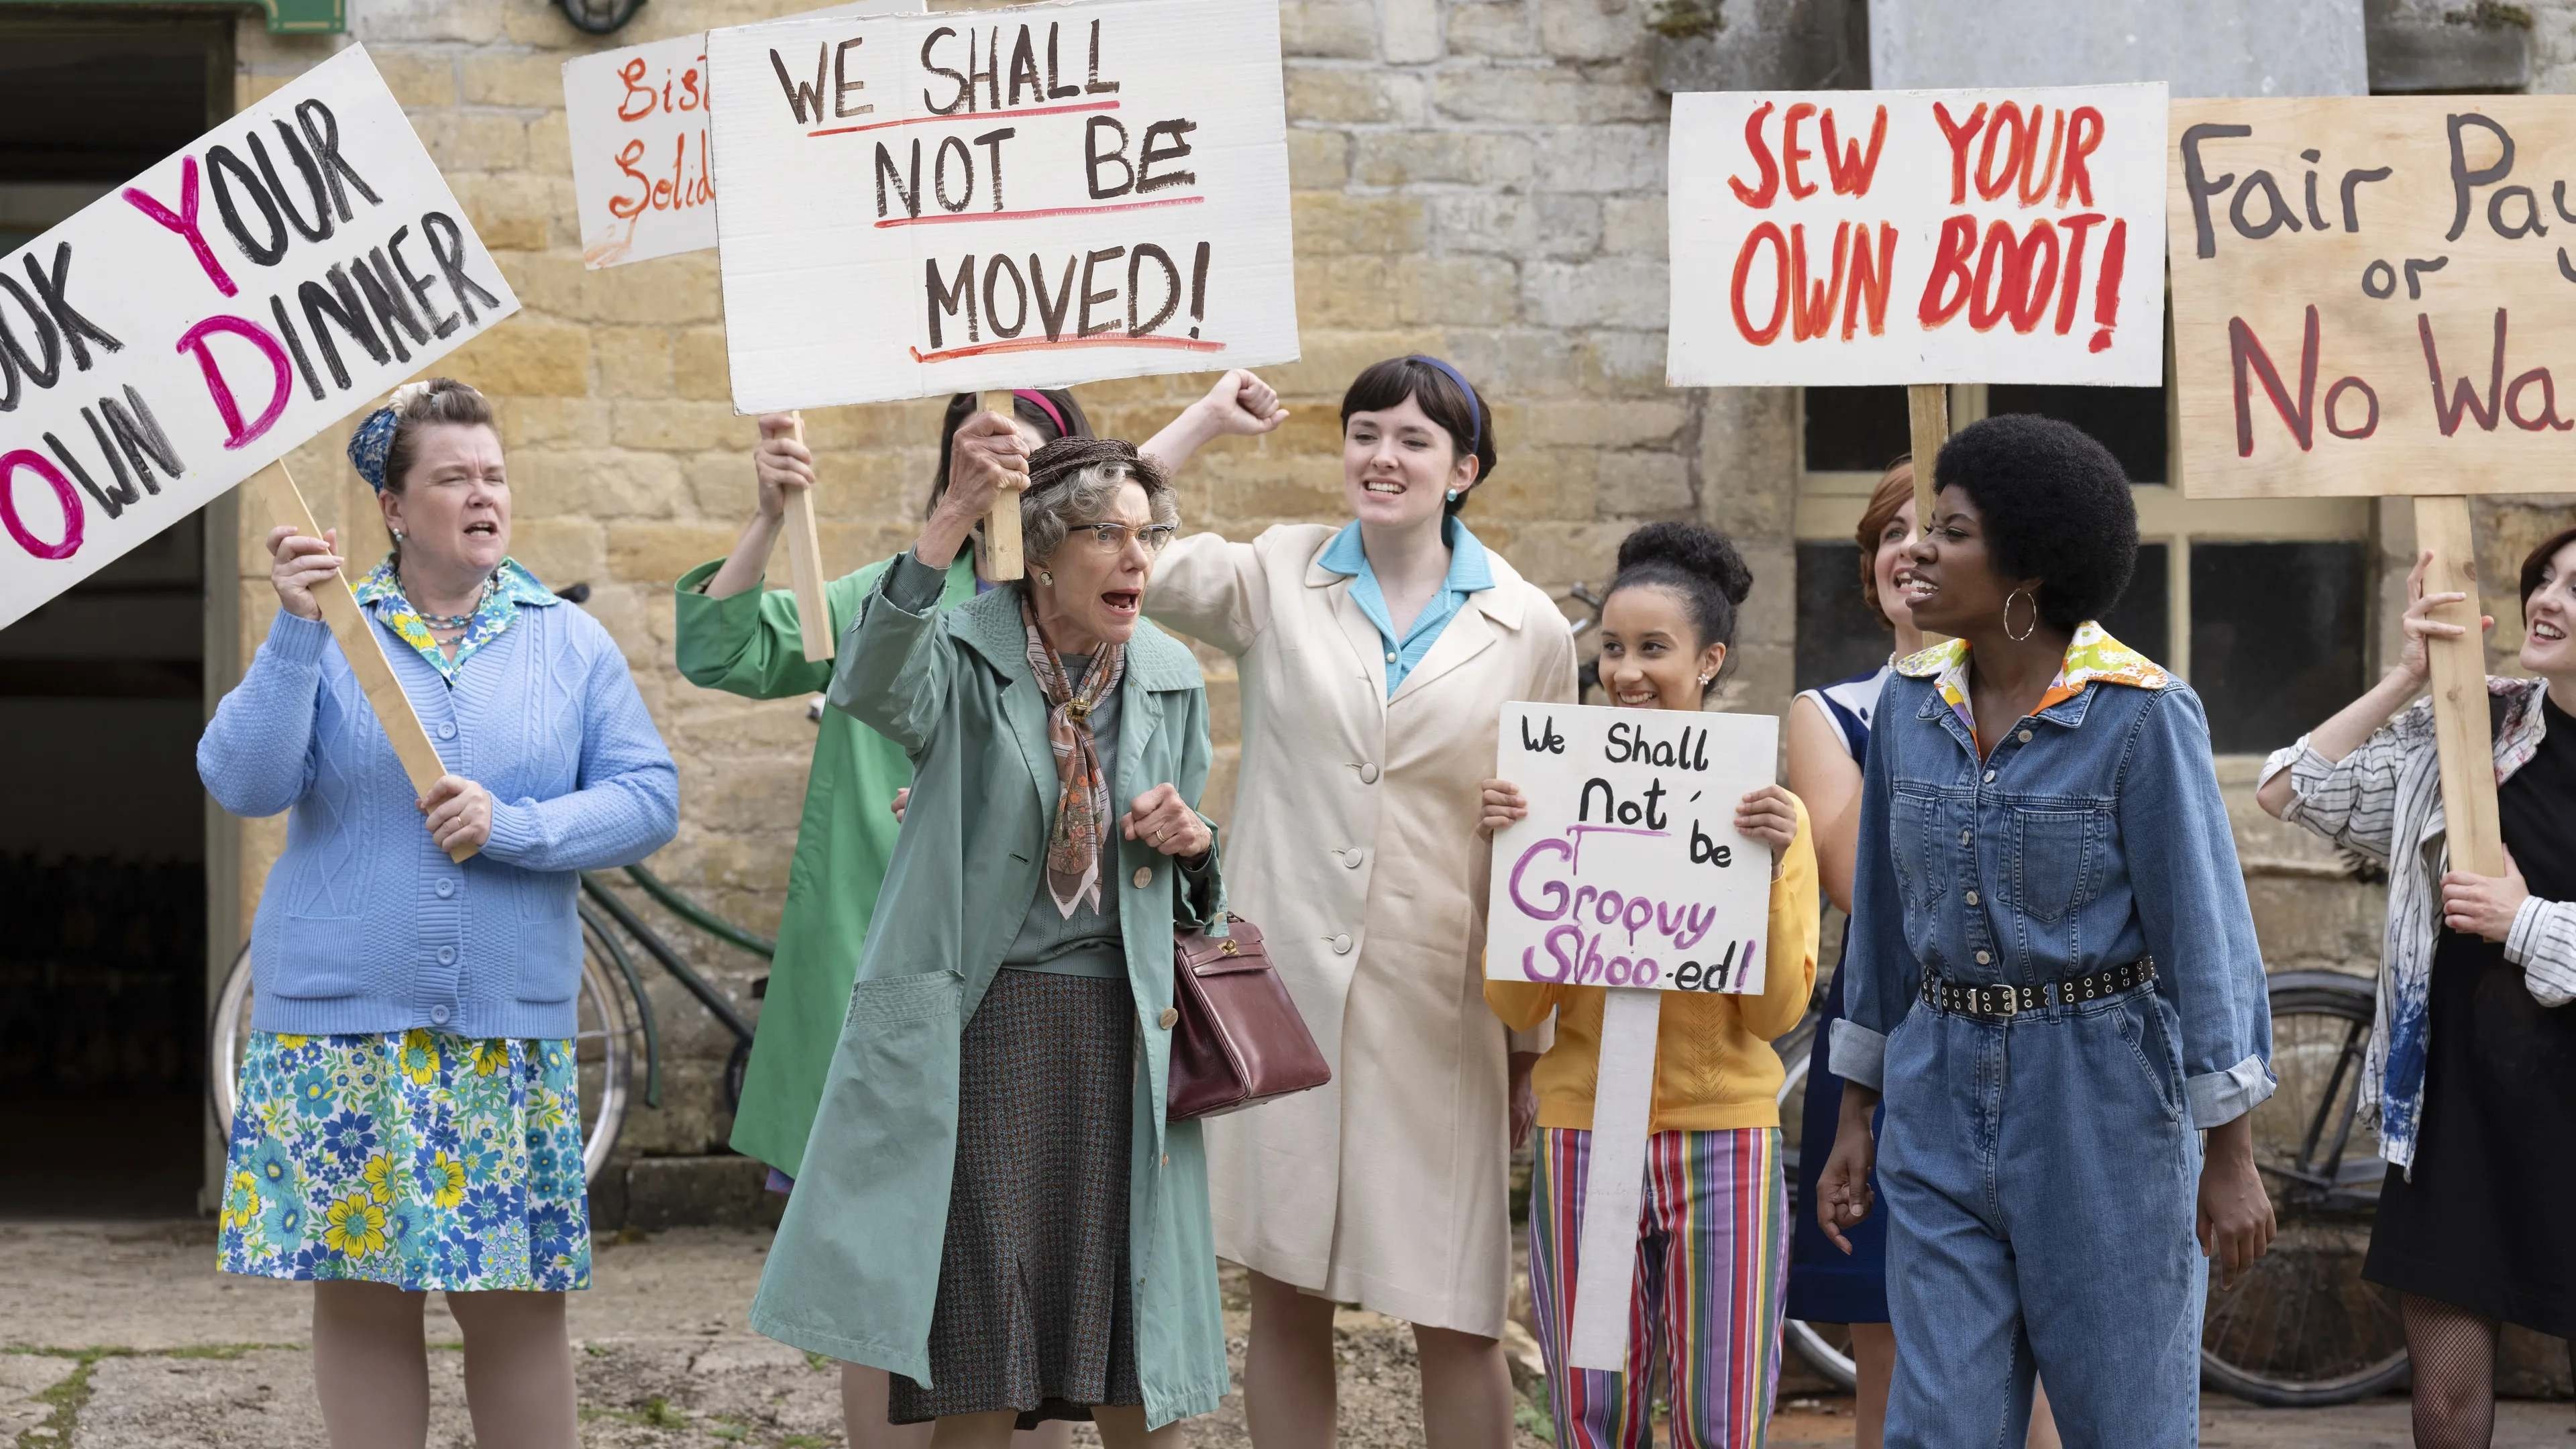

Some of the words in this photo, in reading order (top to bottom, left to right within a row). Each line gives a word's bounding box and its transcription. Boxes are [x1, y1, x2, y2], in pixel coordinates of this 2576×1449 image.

[769, 37, 874, 125] WE
[922, 18, 1120, 115] SHALL
[875, 127, 1016, 219] NOT
[1085, 115, 1197, 201] BE
[1727, 101, 1888, 209] SEW
[1933, 100, 2105, 209] YOUR
[2180, 123, 2393, 259] Fair
[0, 241, 125, 412] OK
[122, 99, 382, 297] YOUR
[925, 241, 1211, 349] MOVED!
[1730, 220, 1898, 346] OWN
[1918, 213, 2127, 353] BOOT!
[2362, 256, 2449, 300] or
[0, 383, 184, 559] OWN
[176, 211, 499, 450] DINNER
[2229, 304, 2379, 457] No
[1521, 714, 1565, 755] We
[1605, 722, 1709, 771] Shall
[1509, 838, 1717, 950] Groovy
[1689, 818, 1732, 868] be
